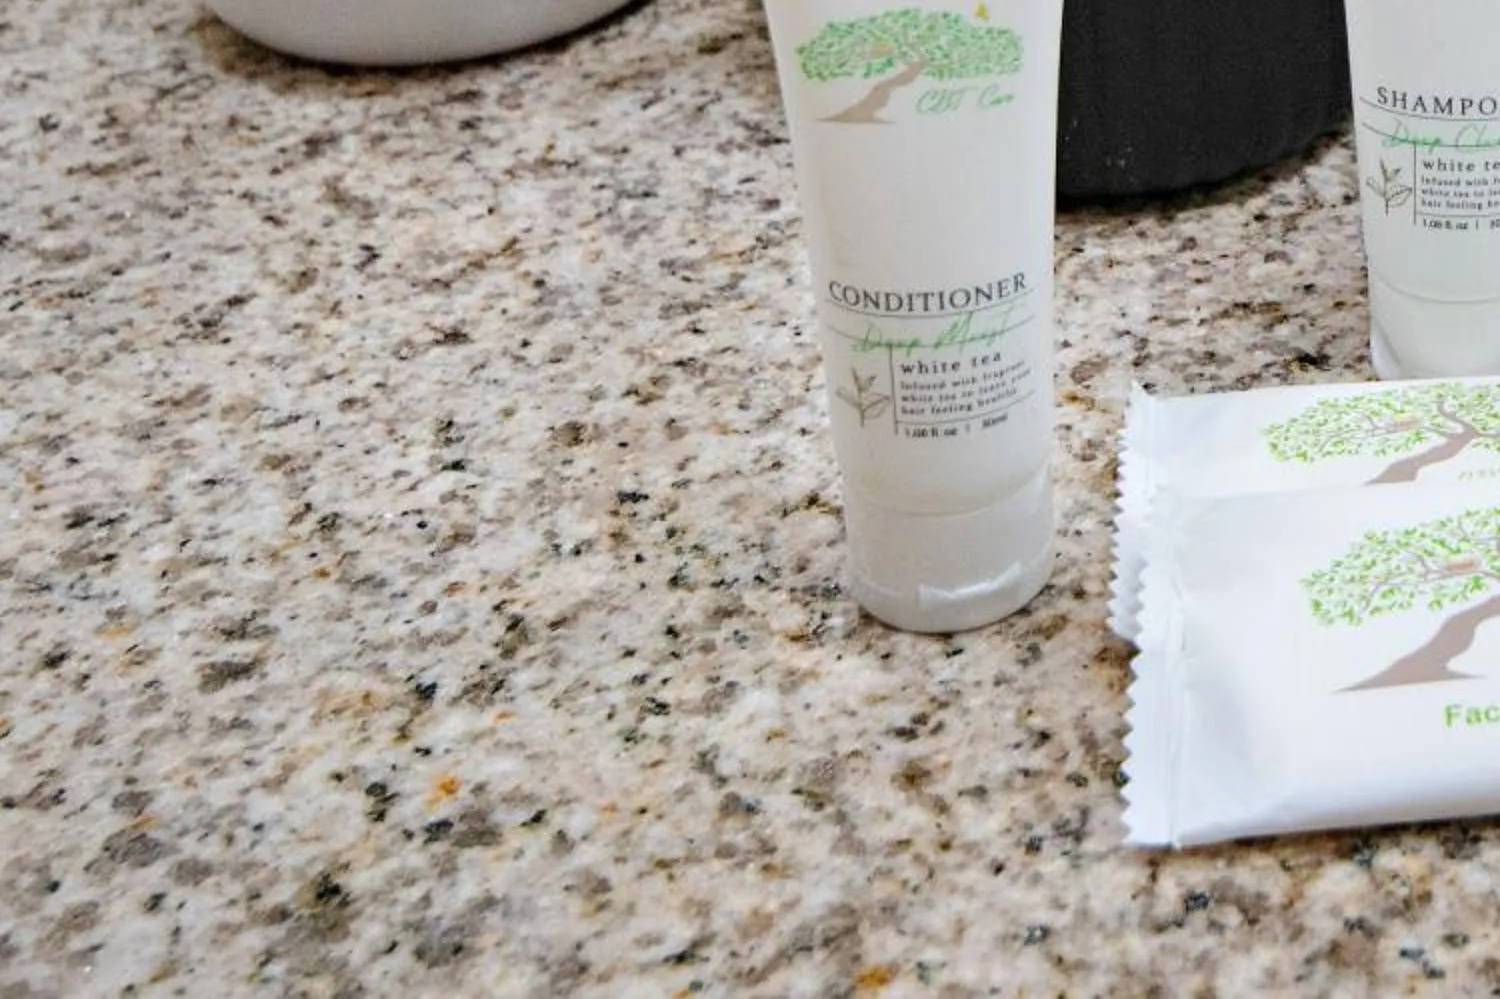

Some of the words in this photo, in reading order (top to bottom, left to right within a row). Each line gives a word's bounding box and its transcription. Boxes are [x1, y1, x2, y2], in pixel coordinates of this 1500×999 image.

[1423, 158, 1475, 171] white
[829, 272, 1027, 312] CONDITIONER
[900, 360, 960, 374] white
[971, 352, 1001, 368] tea
